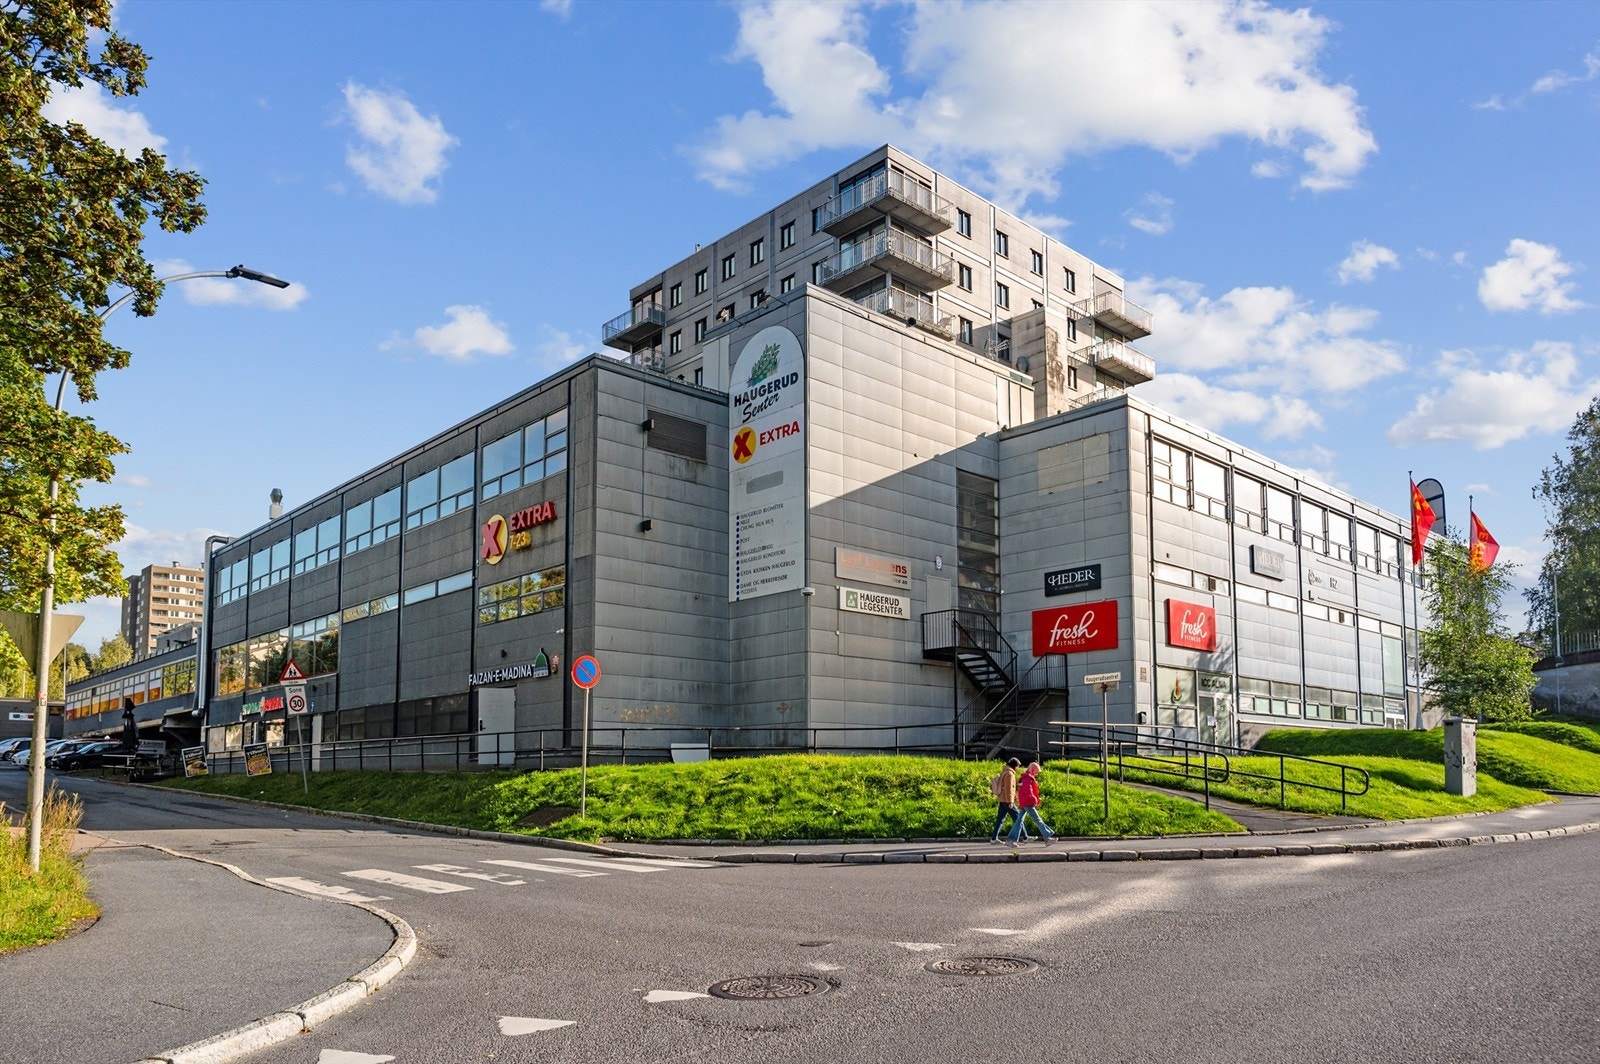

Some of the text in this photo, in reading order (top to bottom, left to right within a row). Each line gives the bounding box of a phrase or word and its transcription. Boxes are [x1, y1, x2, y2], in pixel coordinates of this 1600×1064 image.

[734, 372, 799, 407] HAUGERUD
[742, 392, 780, 423] Senter
[760, 421, 800, 446] EXTRA
[509, 500, 556, 532] EXTRA
[509, 531, 531, 550] 7-23
[860, 593, 900, 607] HAUGERUD
[860, 602, 903, 616] LEGESENTER
[1049, 610, 1098, 648] fresh
[1181, 610, 1207, 639] fresh
[1056, 638, 1086, 647] FITNESS
[292, 699, 302, 708] 30
